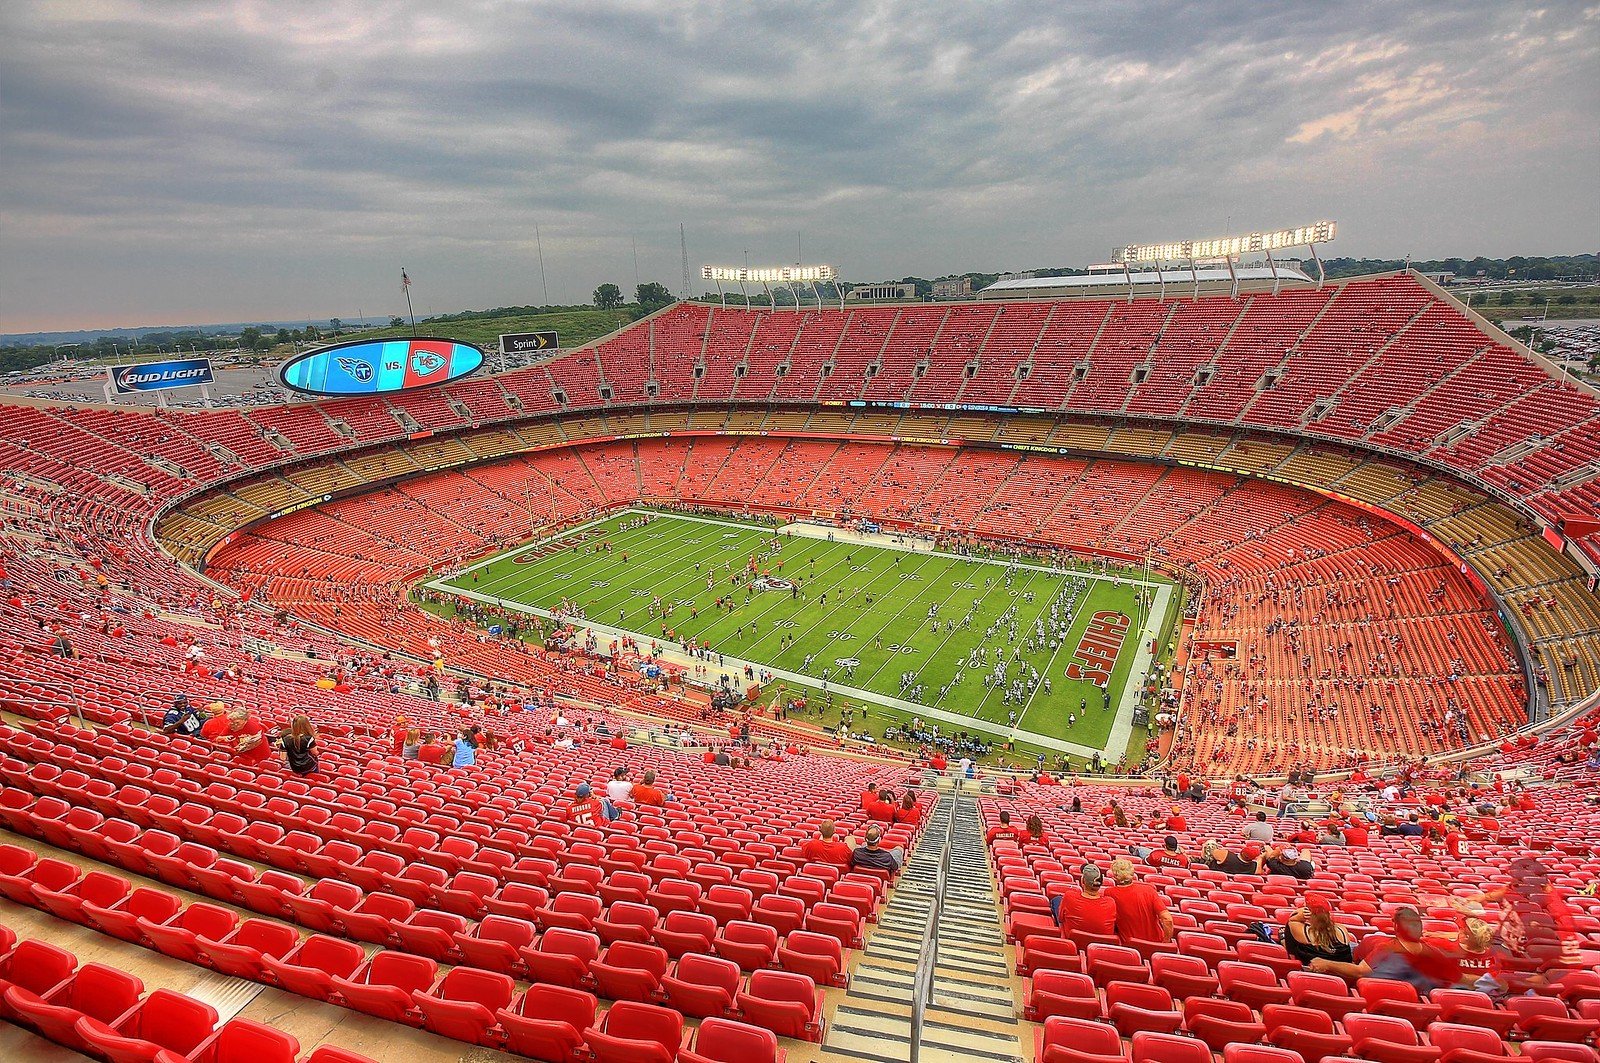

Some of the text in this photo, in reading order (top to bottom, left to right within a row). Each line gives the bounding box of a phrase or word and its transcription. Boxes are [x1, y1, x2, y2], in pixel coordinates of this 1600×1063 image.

[514, 339, 537, 350] Sprint
[126, 368, 208, 384] BUD LIGHT
[1030, 445, 1058, 453] KINGDOM
[827, 630, 851, 641] 30
[887, 643, 913, 655] 20
[1065, 610, 1132, 688] CHIEFS
[513, 739, 525, 752] 87
[575, 812, 595, 826] 15
